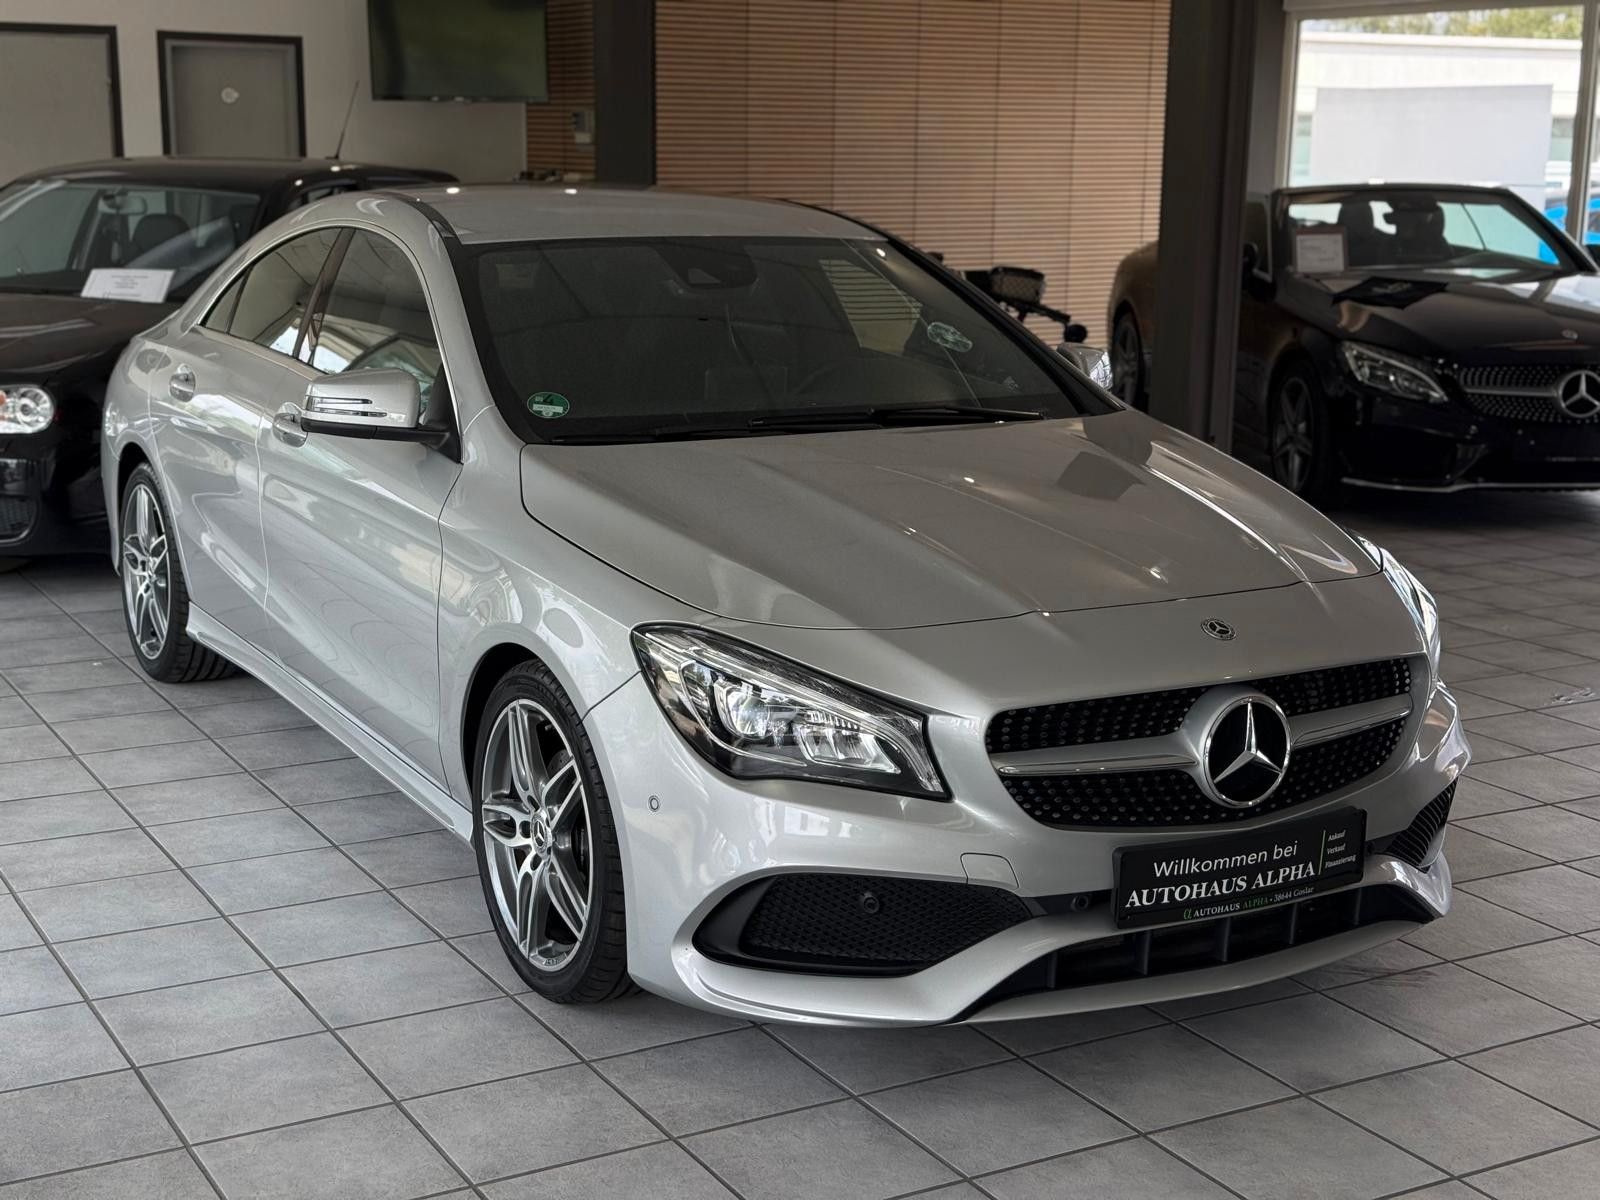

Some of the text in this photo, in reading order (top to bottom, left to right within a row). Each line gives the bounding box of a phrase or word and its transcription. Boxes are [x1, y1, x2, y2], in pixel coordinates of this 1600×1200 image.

[1154, 840, 1298, 877] Willkommen bei
[1125, 861, 1315, 908] AUTOHAUS ALPHA
[1193, 903, 1240, 918] AUTOHAUS
[1242, 896, 1269, 909] ALPHA
[1293, 886, 1314, 898] Goslar
